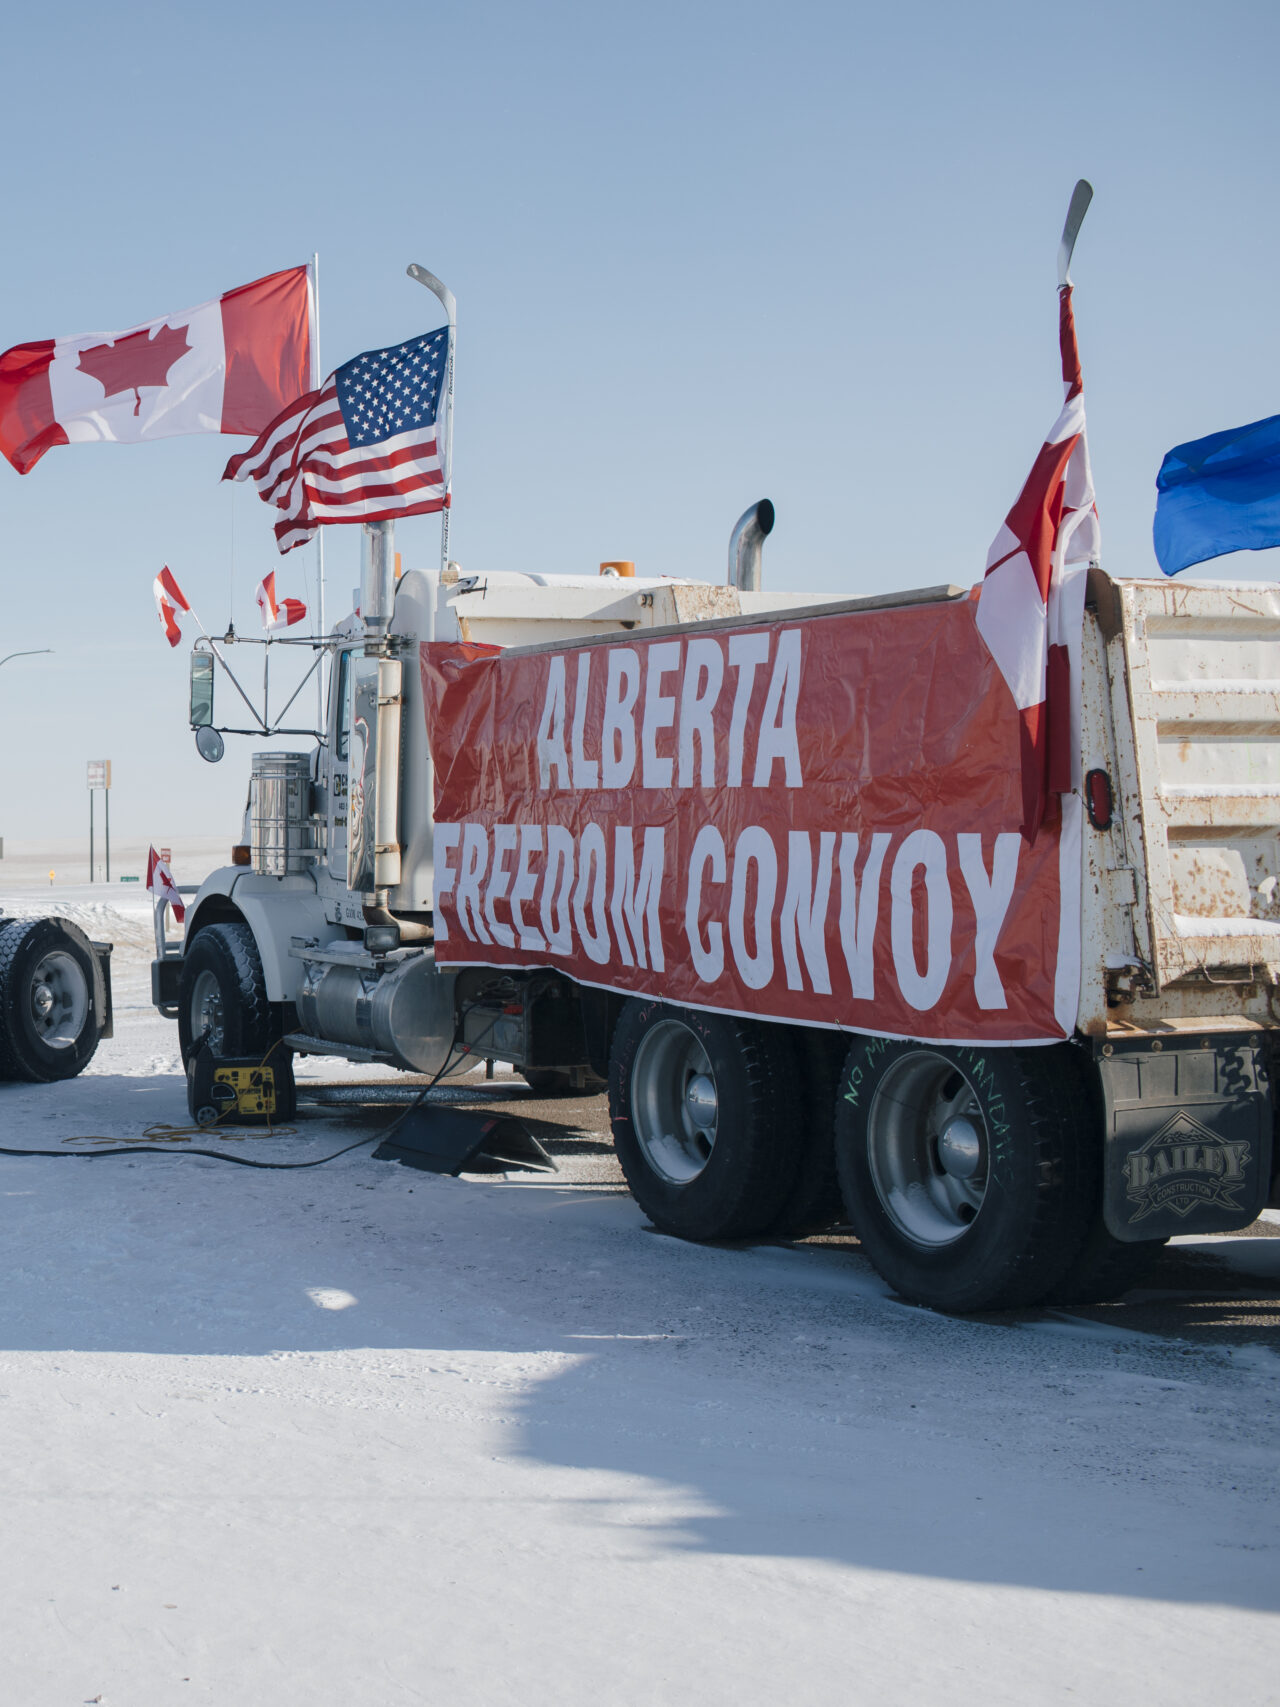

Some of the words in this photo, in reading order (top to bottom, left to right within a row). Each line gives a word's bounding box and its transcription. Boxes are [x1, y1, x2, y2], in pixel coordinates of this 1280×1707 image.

[537, 628, 804, 790] ALBERTA
[433, 822, 666, 973] FREEDOM
[684, 825, 1023, 1012] CONVOY
[842, 1064, 865, 1107] NO
[1128, 1145, 1246, 1190] BAILEY
[1157, 1183, 1212, 1202] CONSTRUCTION
[1175, 1197, 1190, 1206] LTD
